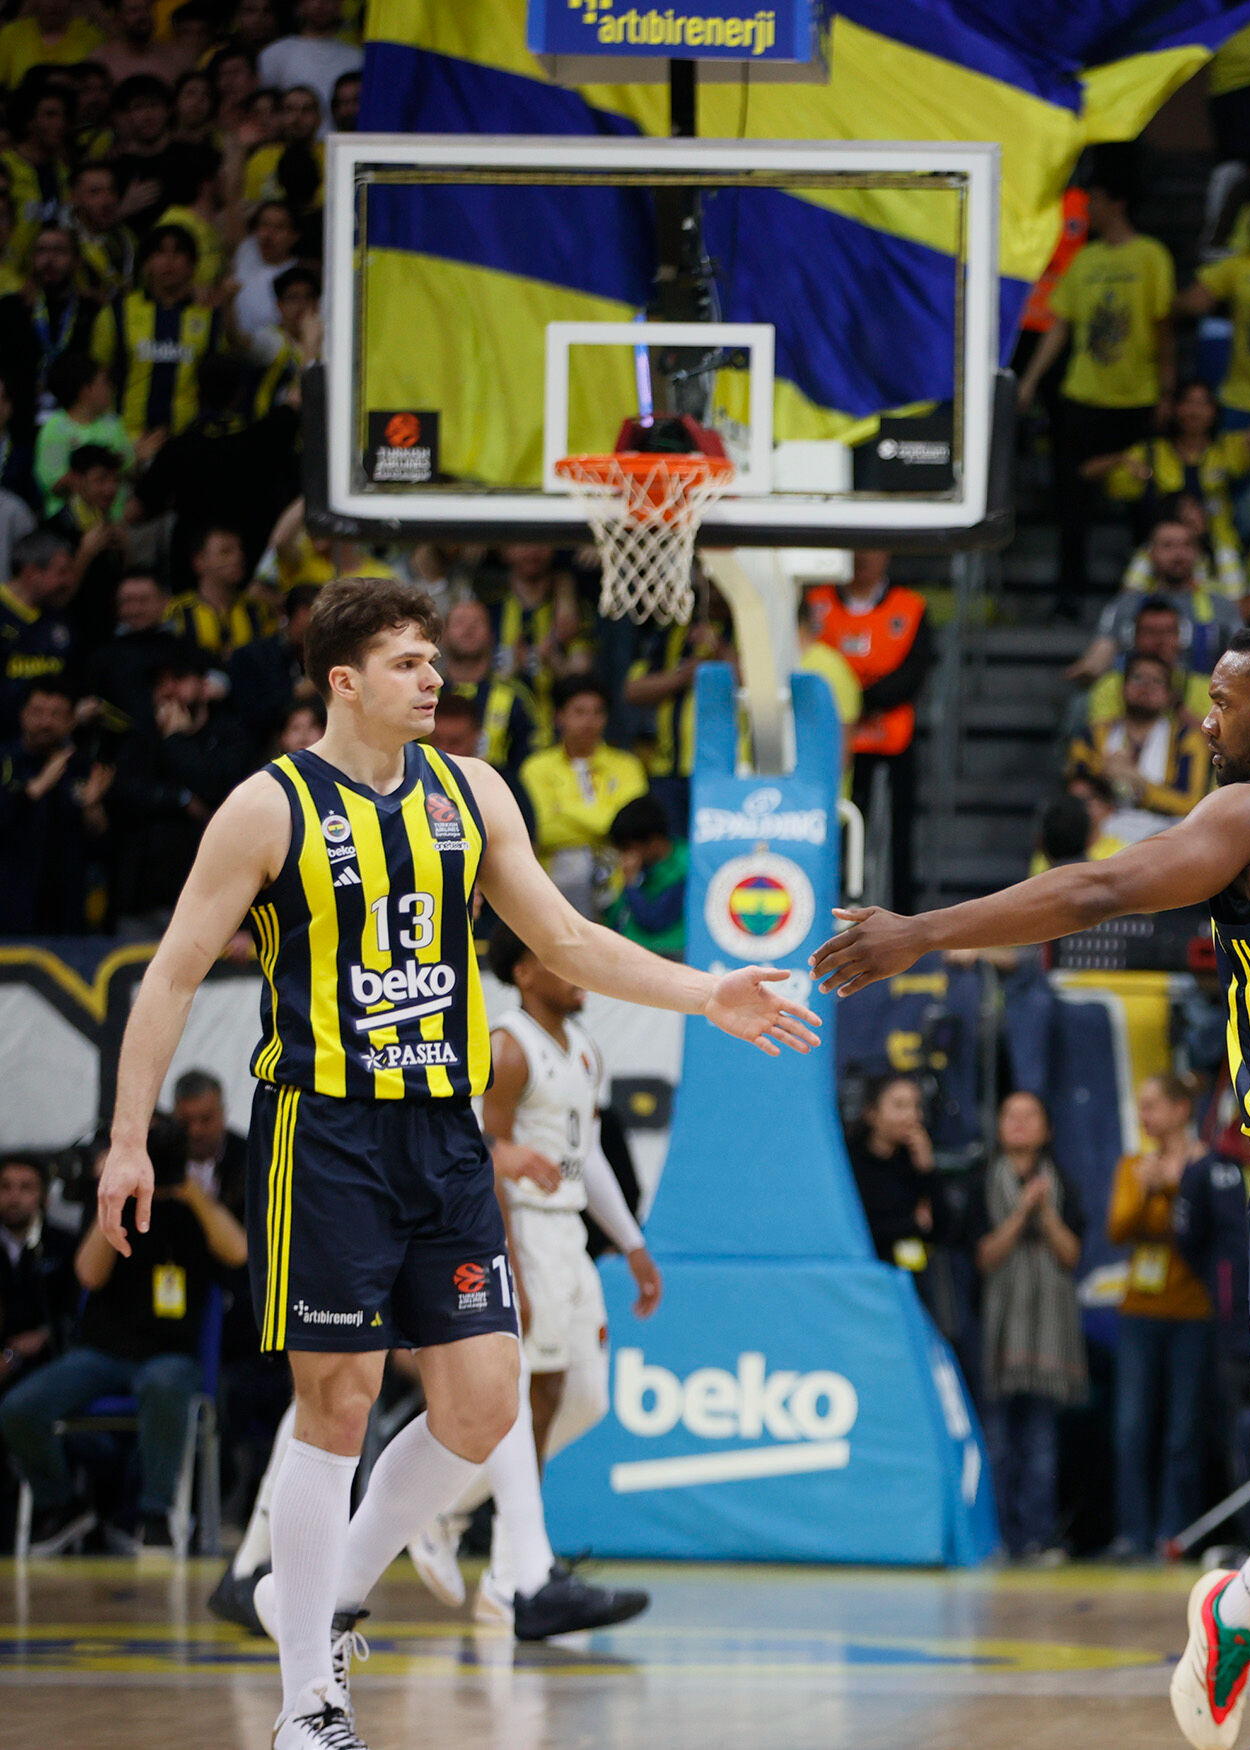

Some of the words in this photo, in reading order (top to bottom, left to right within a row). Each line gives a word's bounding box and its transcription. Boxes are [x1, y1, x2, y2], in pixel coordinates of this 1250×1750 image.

[597, 9, 776, 55] artıbirenerji
[327, 846, 356, 858] beko
[370, 891, 435, 952] 13
[350, 959, 456, 1004] beko
[386, 1042, 458, 1067] PASHA
[491, 1254, 517, 1308] 1
[613, 1346, 859, 1441] beko
